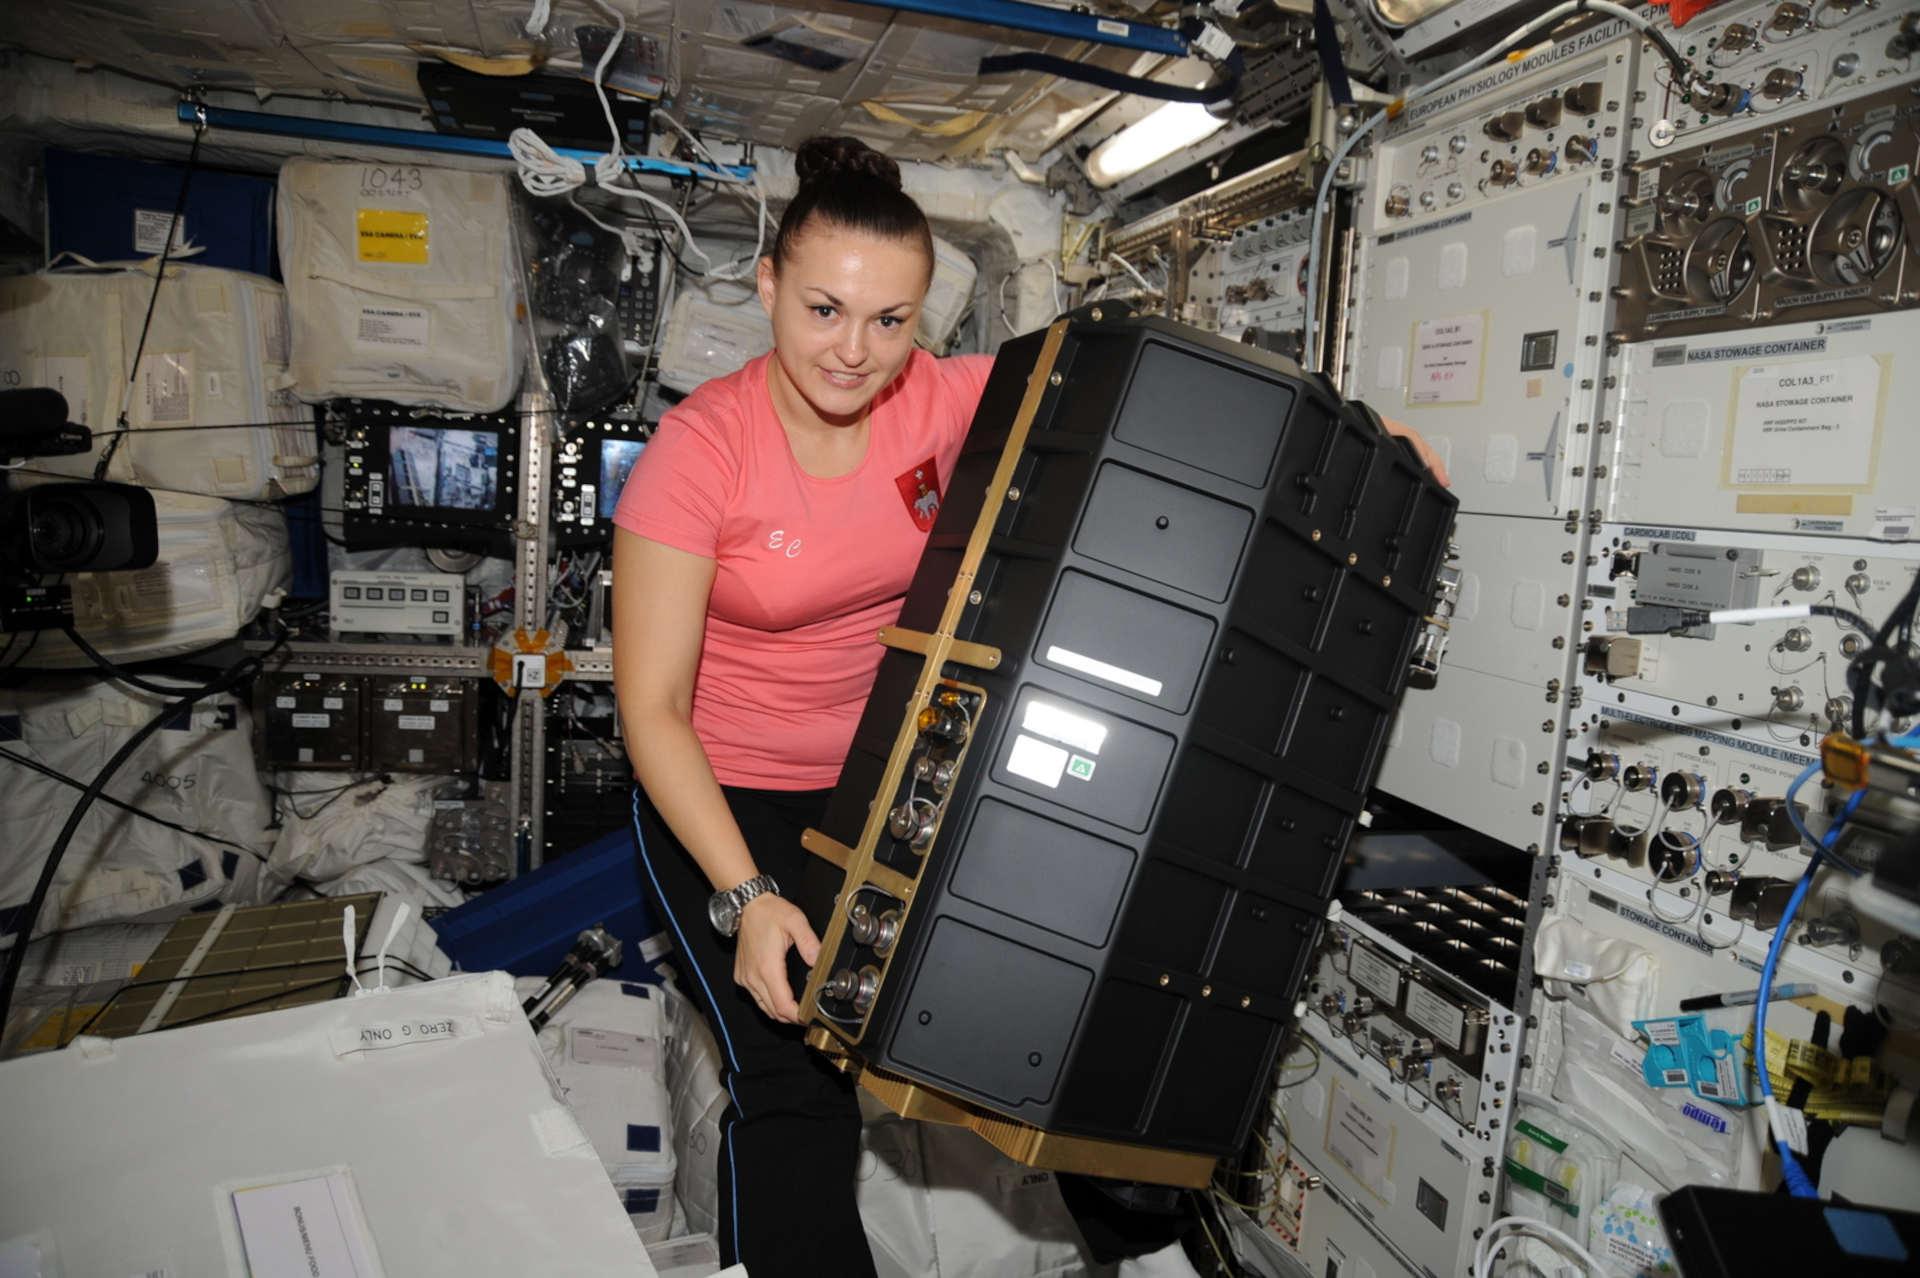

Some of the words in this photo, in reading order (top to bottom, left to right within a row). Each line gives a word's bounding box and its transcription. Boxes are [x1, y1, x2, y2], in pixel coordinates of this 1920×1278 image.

[1409, 93, 1457, 121] EUROPEAN
[1457, 64, 1520, 101] PHYSIOLOGY
[1521, 41, 1576, 75] MODULES
[1578, 18, 1633, 54] FACILITY
[361, 167, 423, 191] 1043
[1687, 349, 1713, 362] NASA
[1714, 345, 1762, 360] STOWAGE
[1764, 339, 1826, 355] CONTAINER
[1776, 398, 1808, 408] STOWAGE
[1810, 394, 1854, 405] CONTAINER
[1623, 527, 1672, 540] CARDIOLAB
[1694, 728, 1735, 748] MAPPING
[1736, 738, 1778, 759] MODULE
[1619, 906, 1661, 932] STOWAGE
[1661, 925, 1714, 955] CONTAINER
[360, 1028, 393, 1041] ONLY
[401, 1024, 412, 1036] G
[420, 1022, 455, 1035] ZERO
[1682, 1103, 1727, 1133] Tempo
[1022, 1172, 1049, 1187] ONLY
